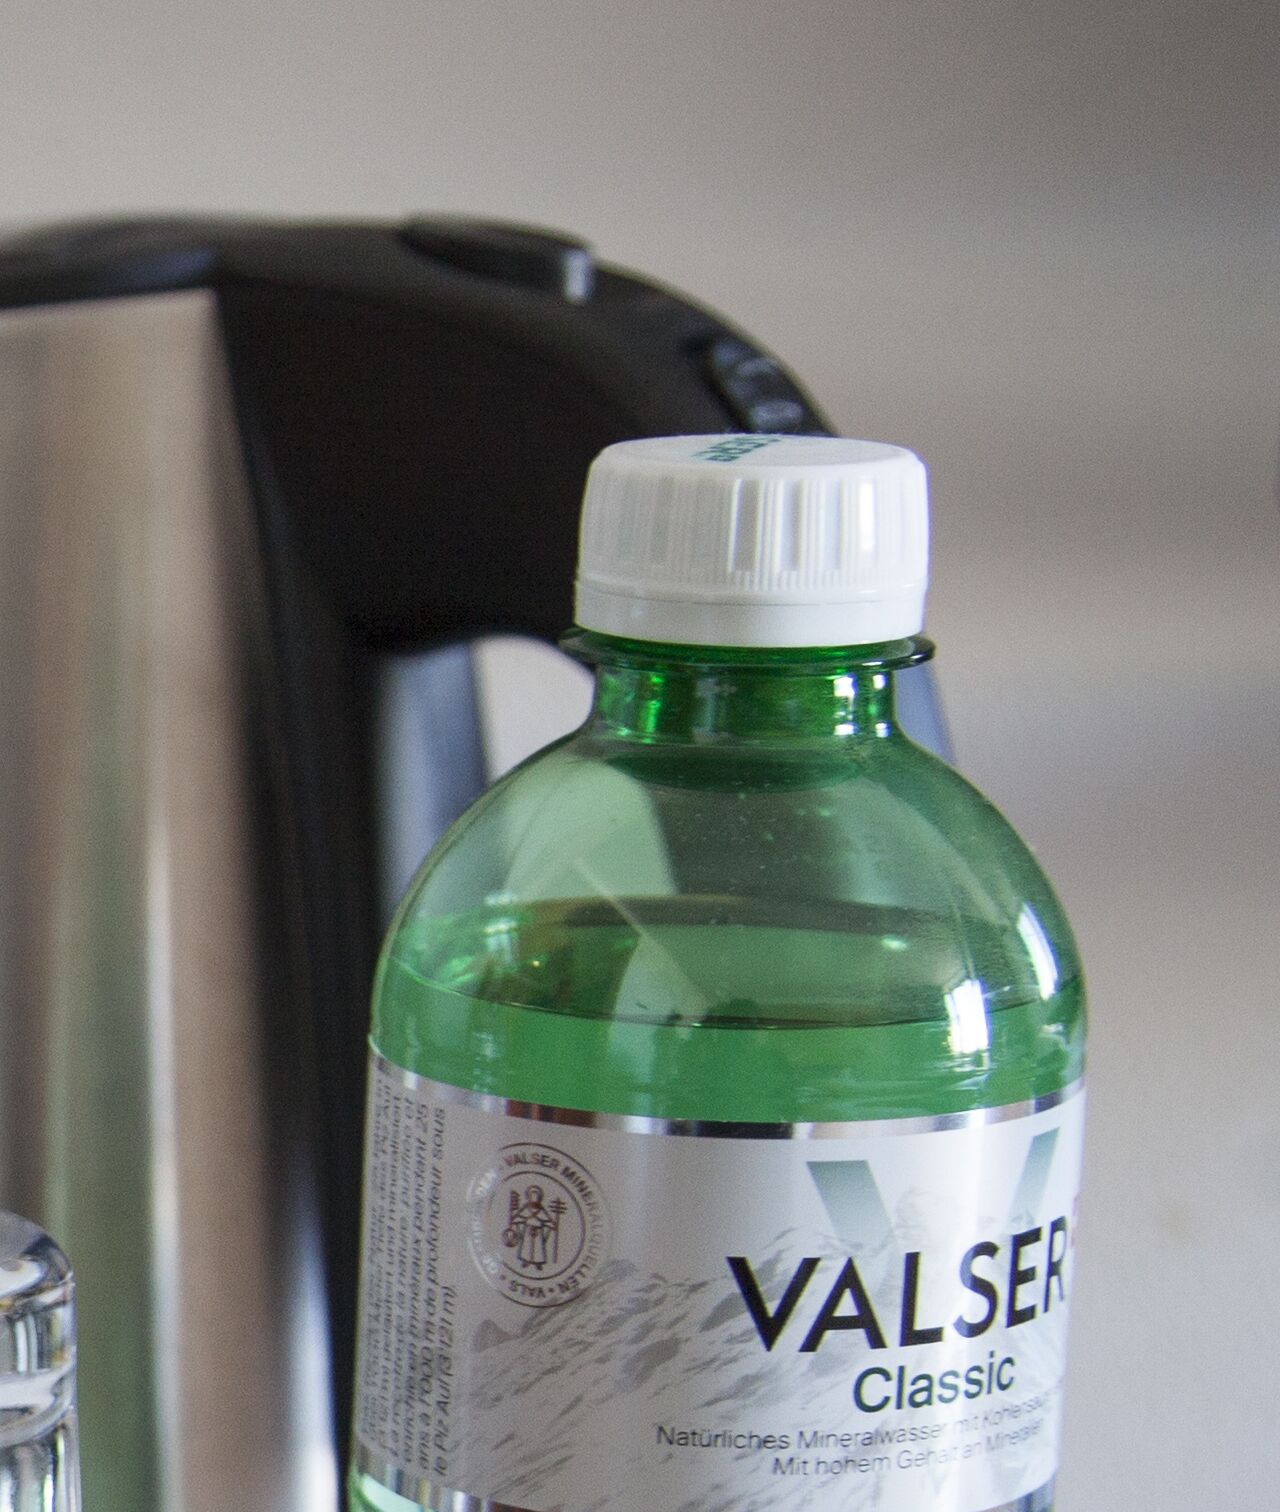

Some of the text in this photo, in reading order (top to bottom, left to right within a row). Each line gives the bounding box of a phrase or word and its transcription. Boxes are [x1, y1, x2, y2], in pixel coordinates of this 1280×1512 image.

[431, 1107, 445, 1161] sous
[426, 1166, 442, 1285] profondeur
[726, 1215, 1067, 1352] VALSER
[853, 1350, 1015, 1413] Classic
[656, 1424, 791, 1450] Natürliches
[797, 1421, 947, 1449] Mineralwasser
[773, 1456, 809, 1476] Mit
[815, 1454, 889, 1475] hohem
